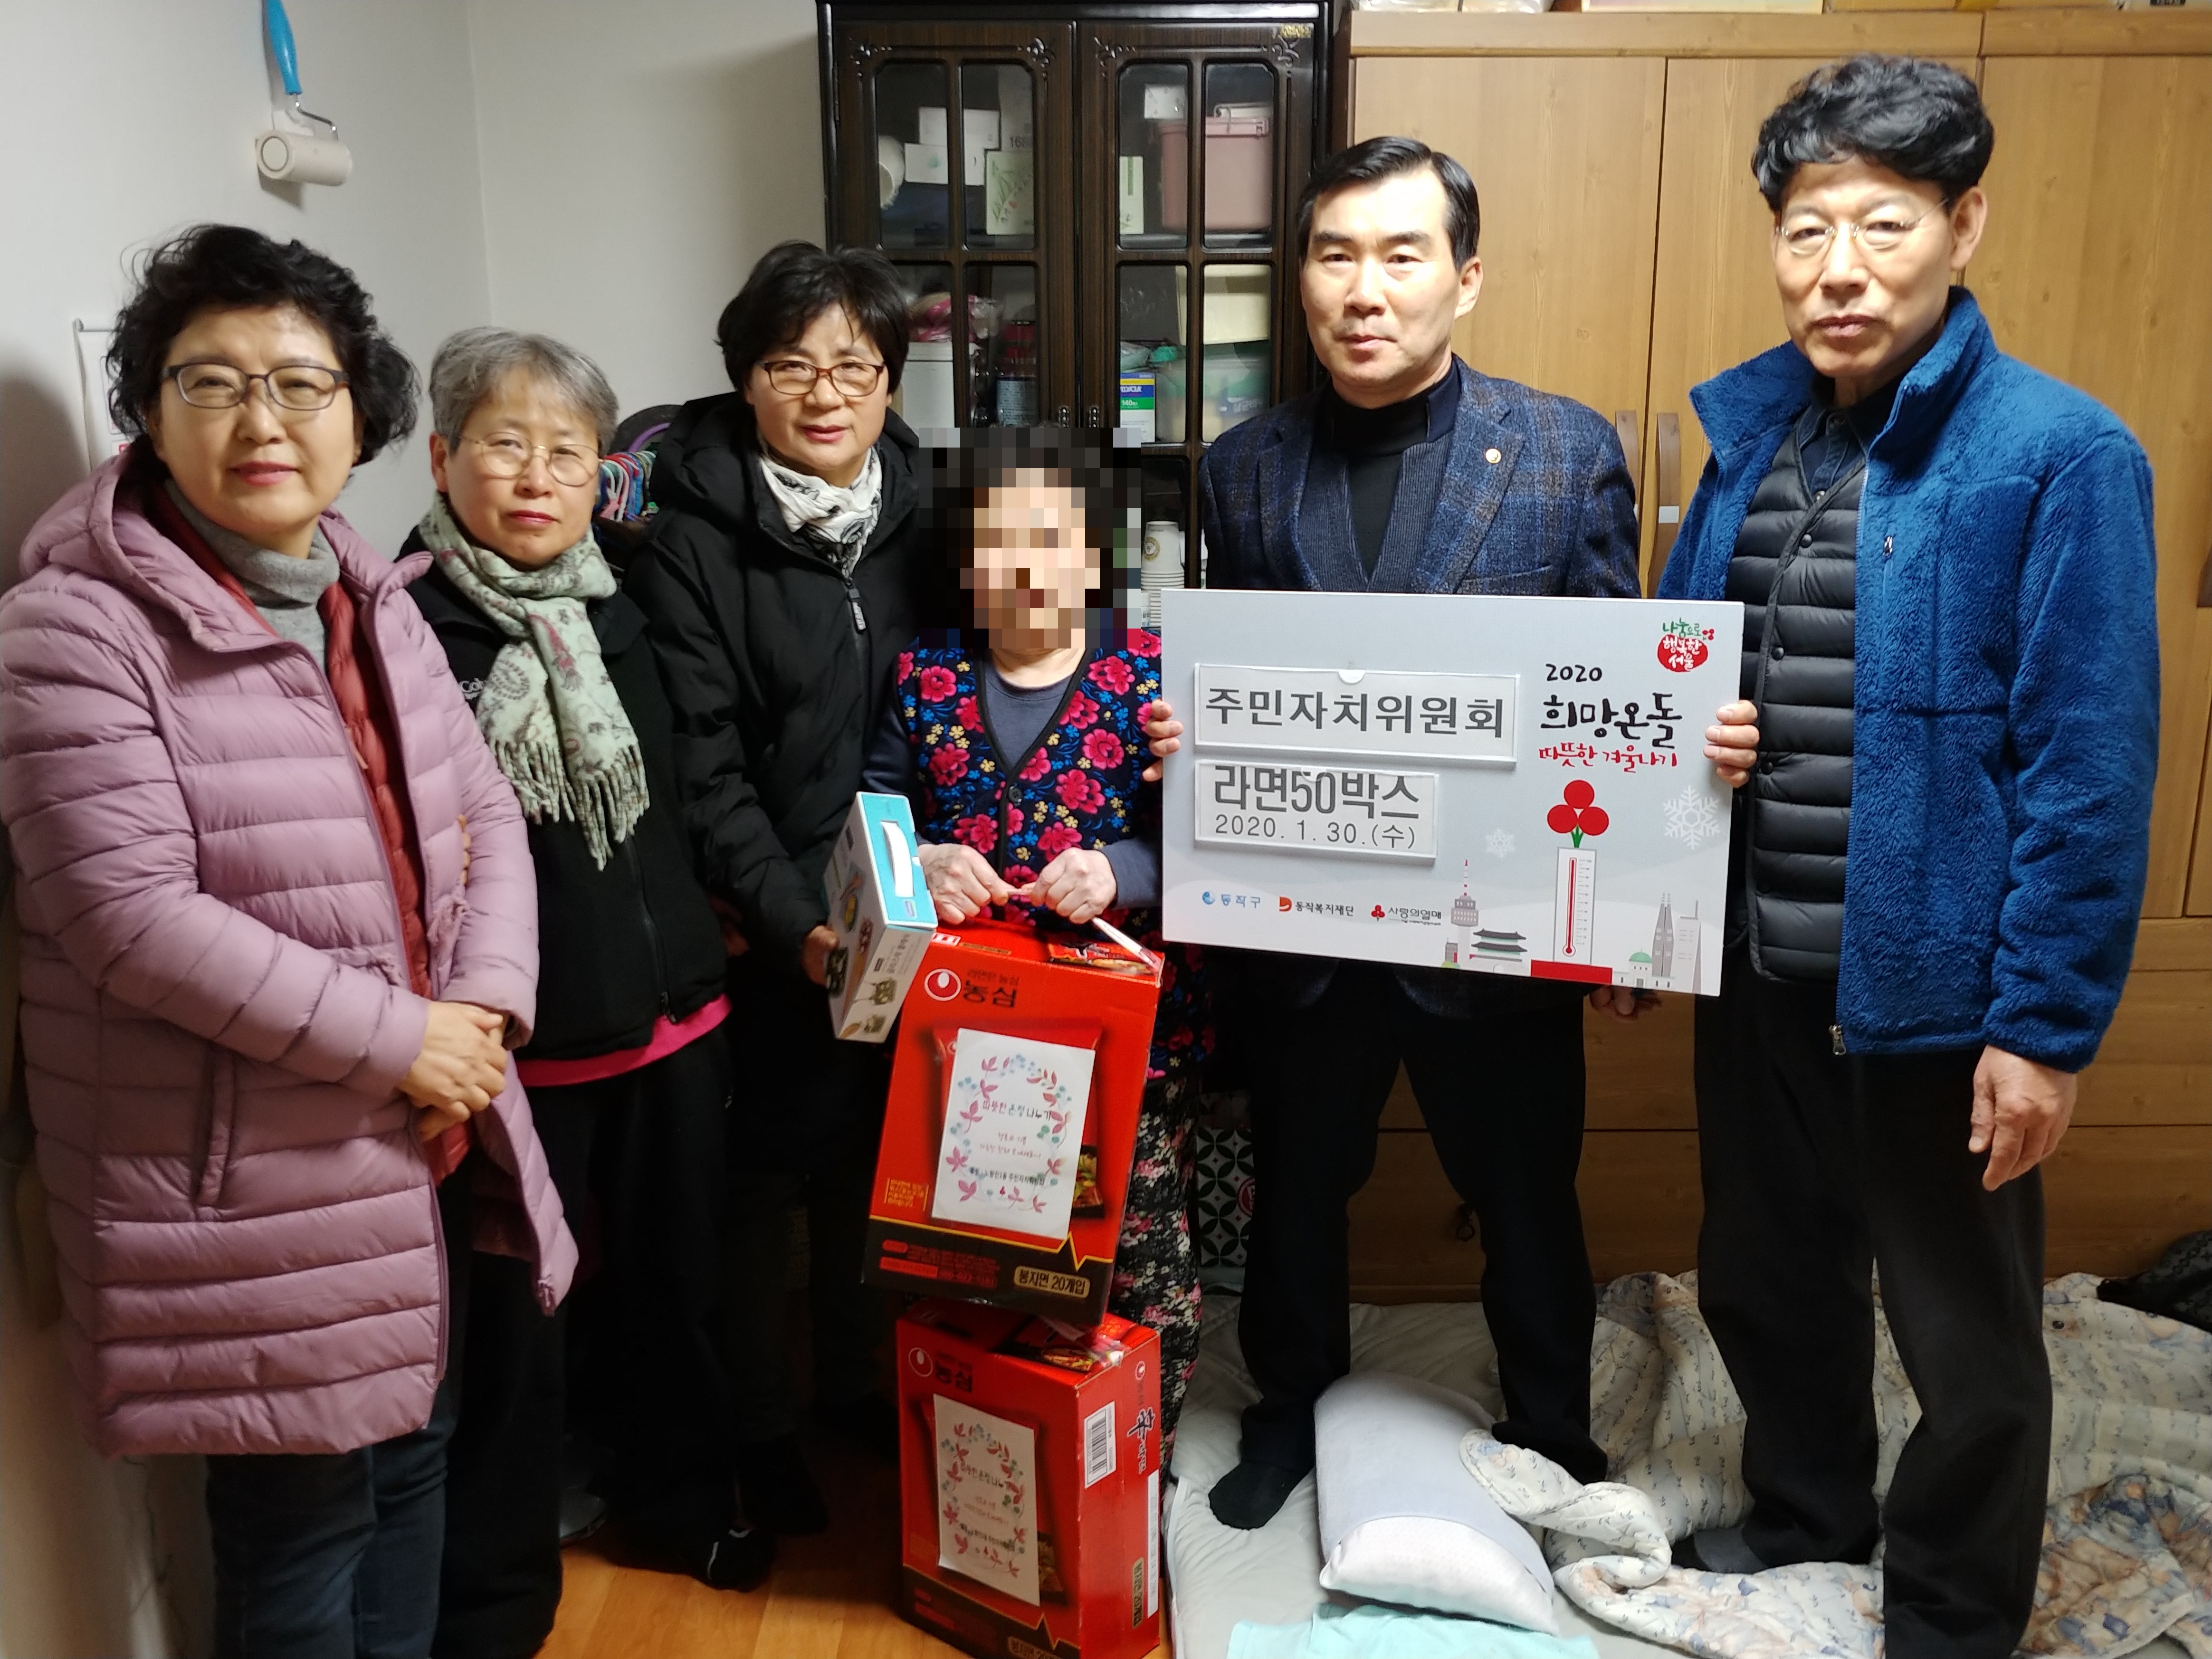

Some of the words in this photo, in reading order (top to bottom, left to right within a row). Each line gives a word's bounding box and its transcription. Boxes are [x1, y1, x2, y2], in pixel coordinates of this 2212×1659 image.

[1662, 618, 1701, 638] 나눔으로
[1663, 636, 1702, 656] 행복한
[1669, 653, 1694, 671] 서울
[1546, 664, 1602, 682] 2020
[1206, 688, 1503, 738] 주민자치위원회
[1541, 693, 1682, 748] 희망온돌
[1539, 743, 1598, 767] 따뜻한
[1602, 745, 1677, 773] 겨울나기
[1215, 765, 1419, 819] 라면50박스
[1221, 894, 1260, 908] 동작구
[1296, 901, 1354, 916] 동작복지재단
[1389, 907, 1441, 920] 사랑의열매
[963, 981, 1016, 1007] 농심
[1019, 1269, 1049, 1287] 봉지면
[1051, 1275, 1085, 1295] 20개입
